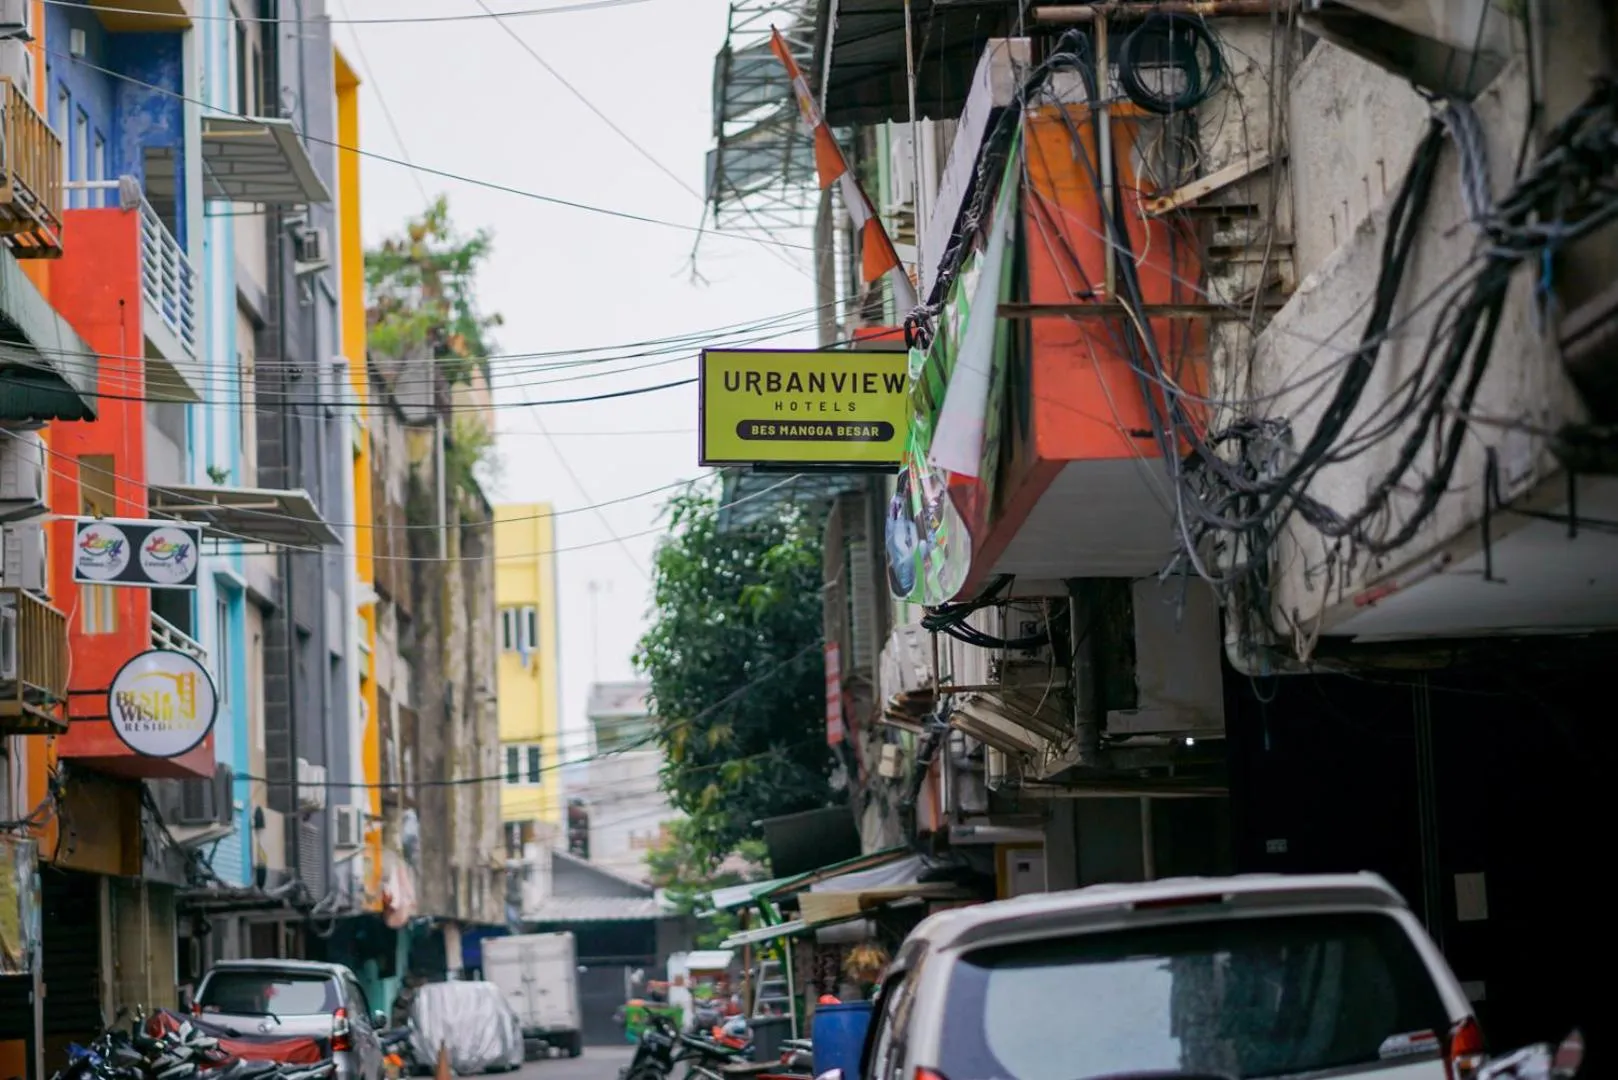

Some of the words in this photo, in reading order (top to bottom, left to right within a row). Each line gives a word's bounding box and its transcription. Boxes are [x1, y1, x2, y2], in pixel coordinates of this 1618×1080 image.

[723, 370, 906, 396] URBANVIEW
[775, 401, 857, 412] HOTELS
[751, 424, 776, 436] BES
[779, 425, 834, 437] MANGGA
[836, 426, 880, 437] BESAR
